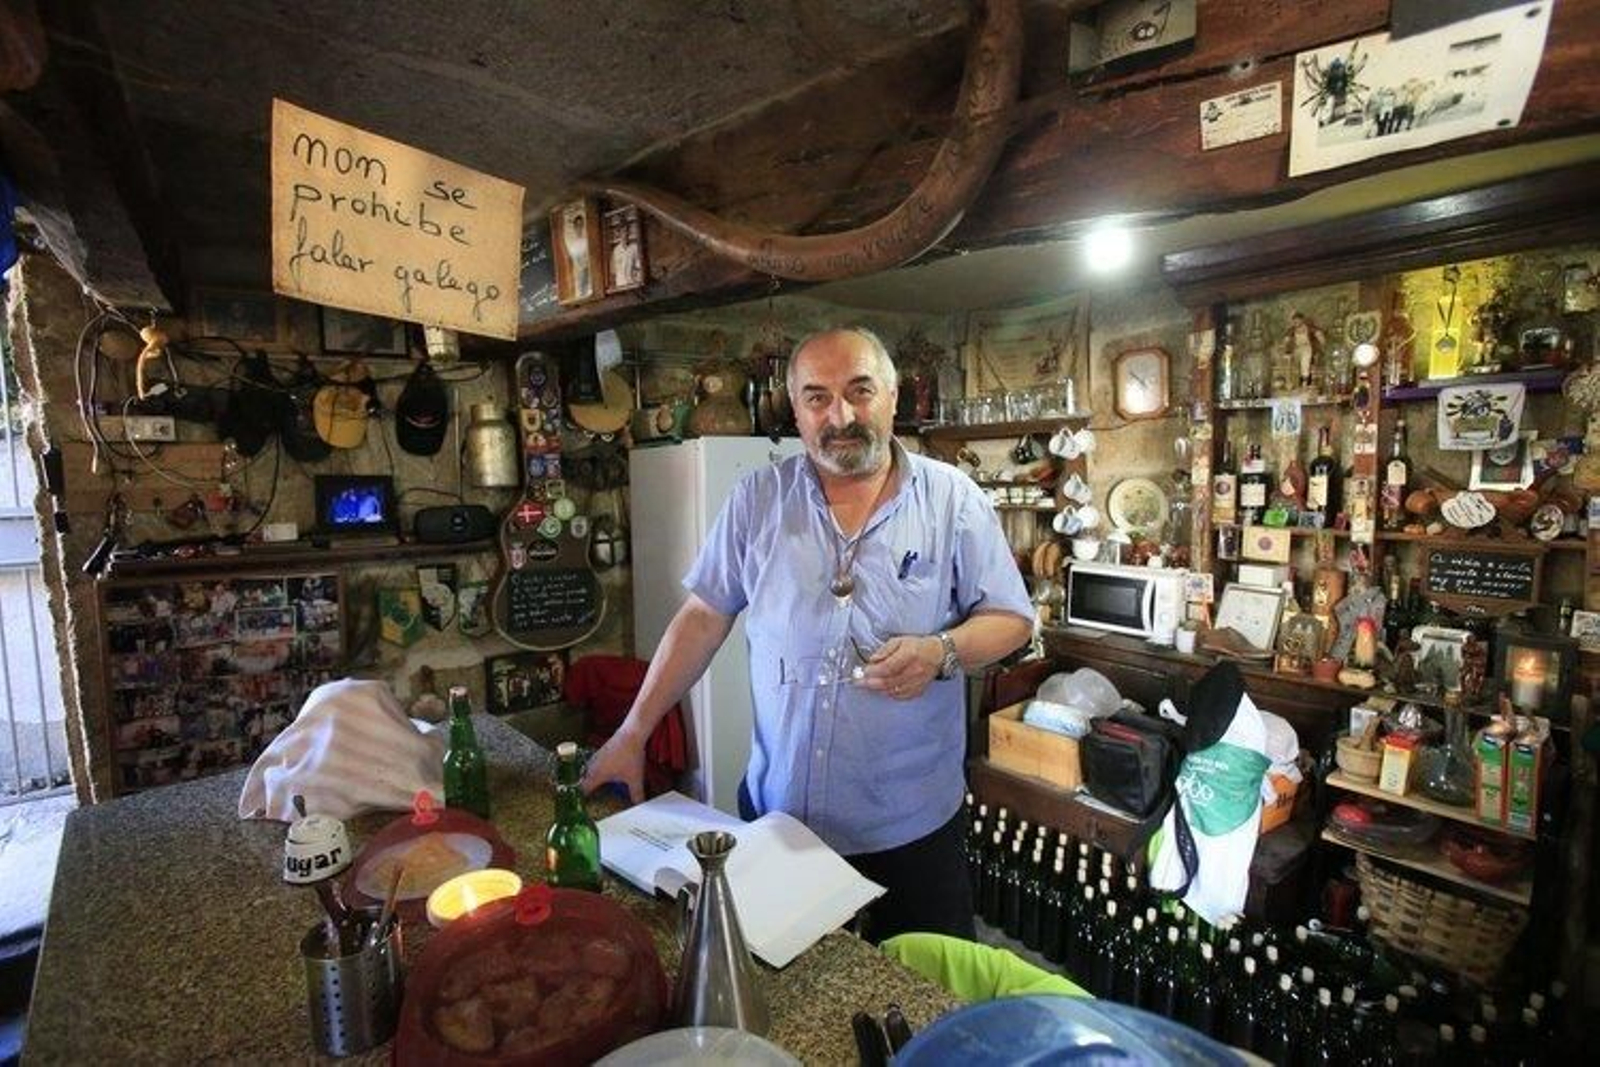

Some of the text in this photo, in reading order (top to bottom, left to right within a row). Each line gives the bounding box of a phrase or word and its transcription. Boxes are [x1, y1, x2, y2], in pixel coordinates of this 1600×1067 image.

[423, 180, 478, 211] se
[289, 216, 501, 323] falar galego
[286, 846, 342, 878] ugar
